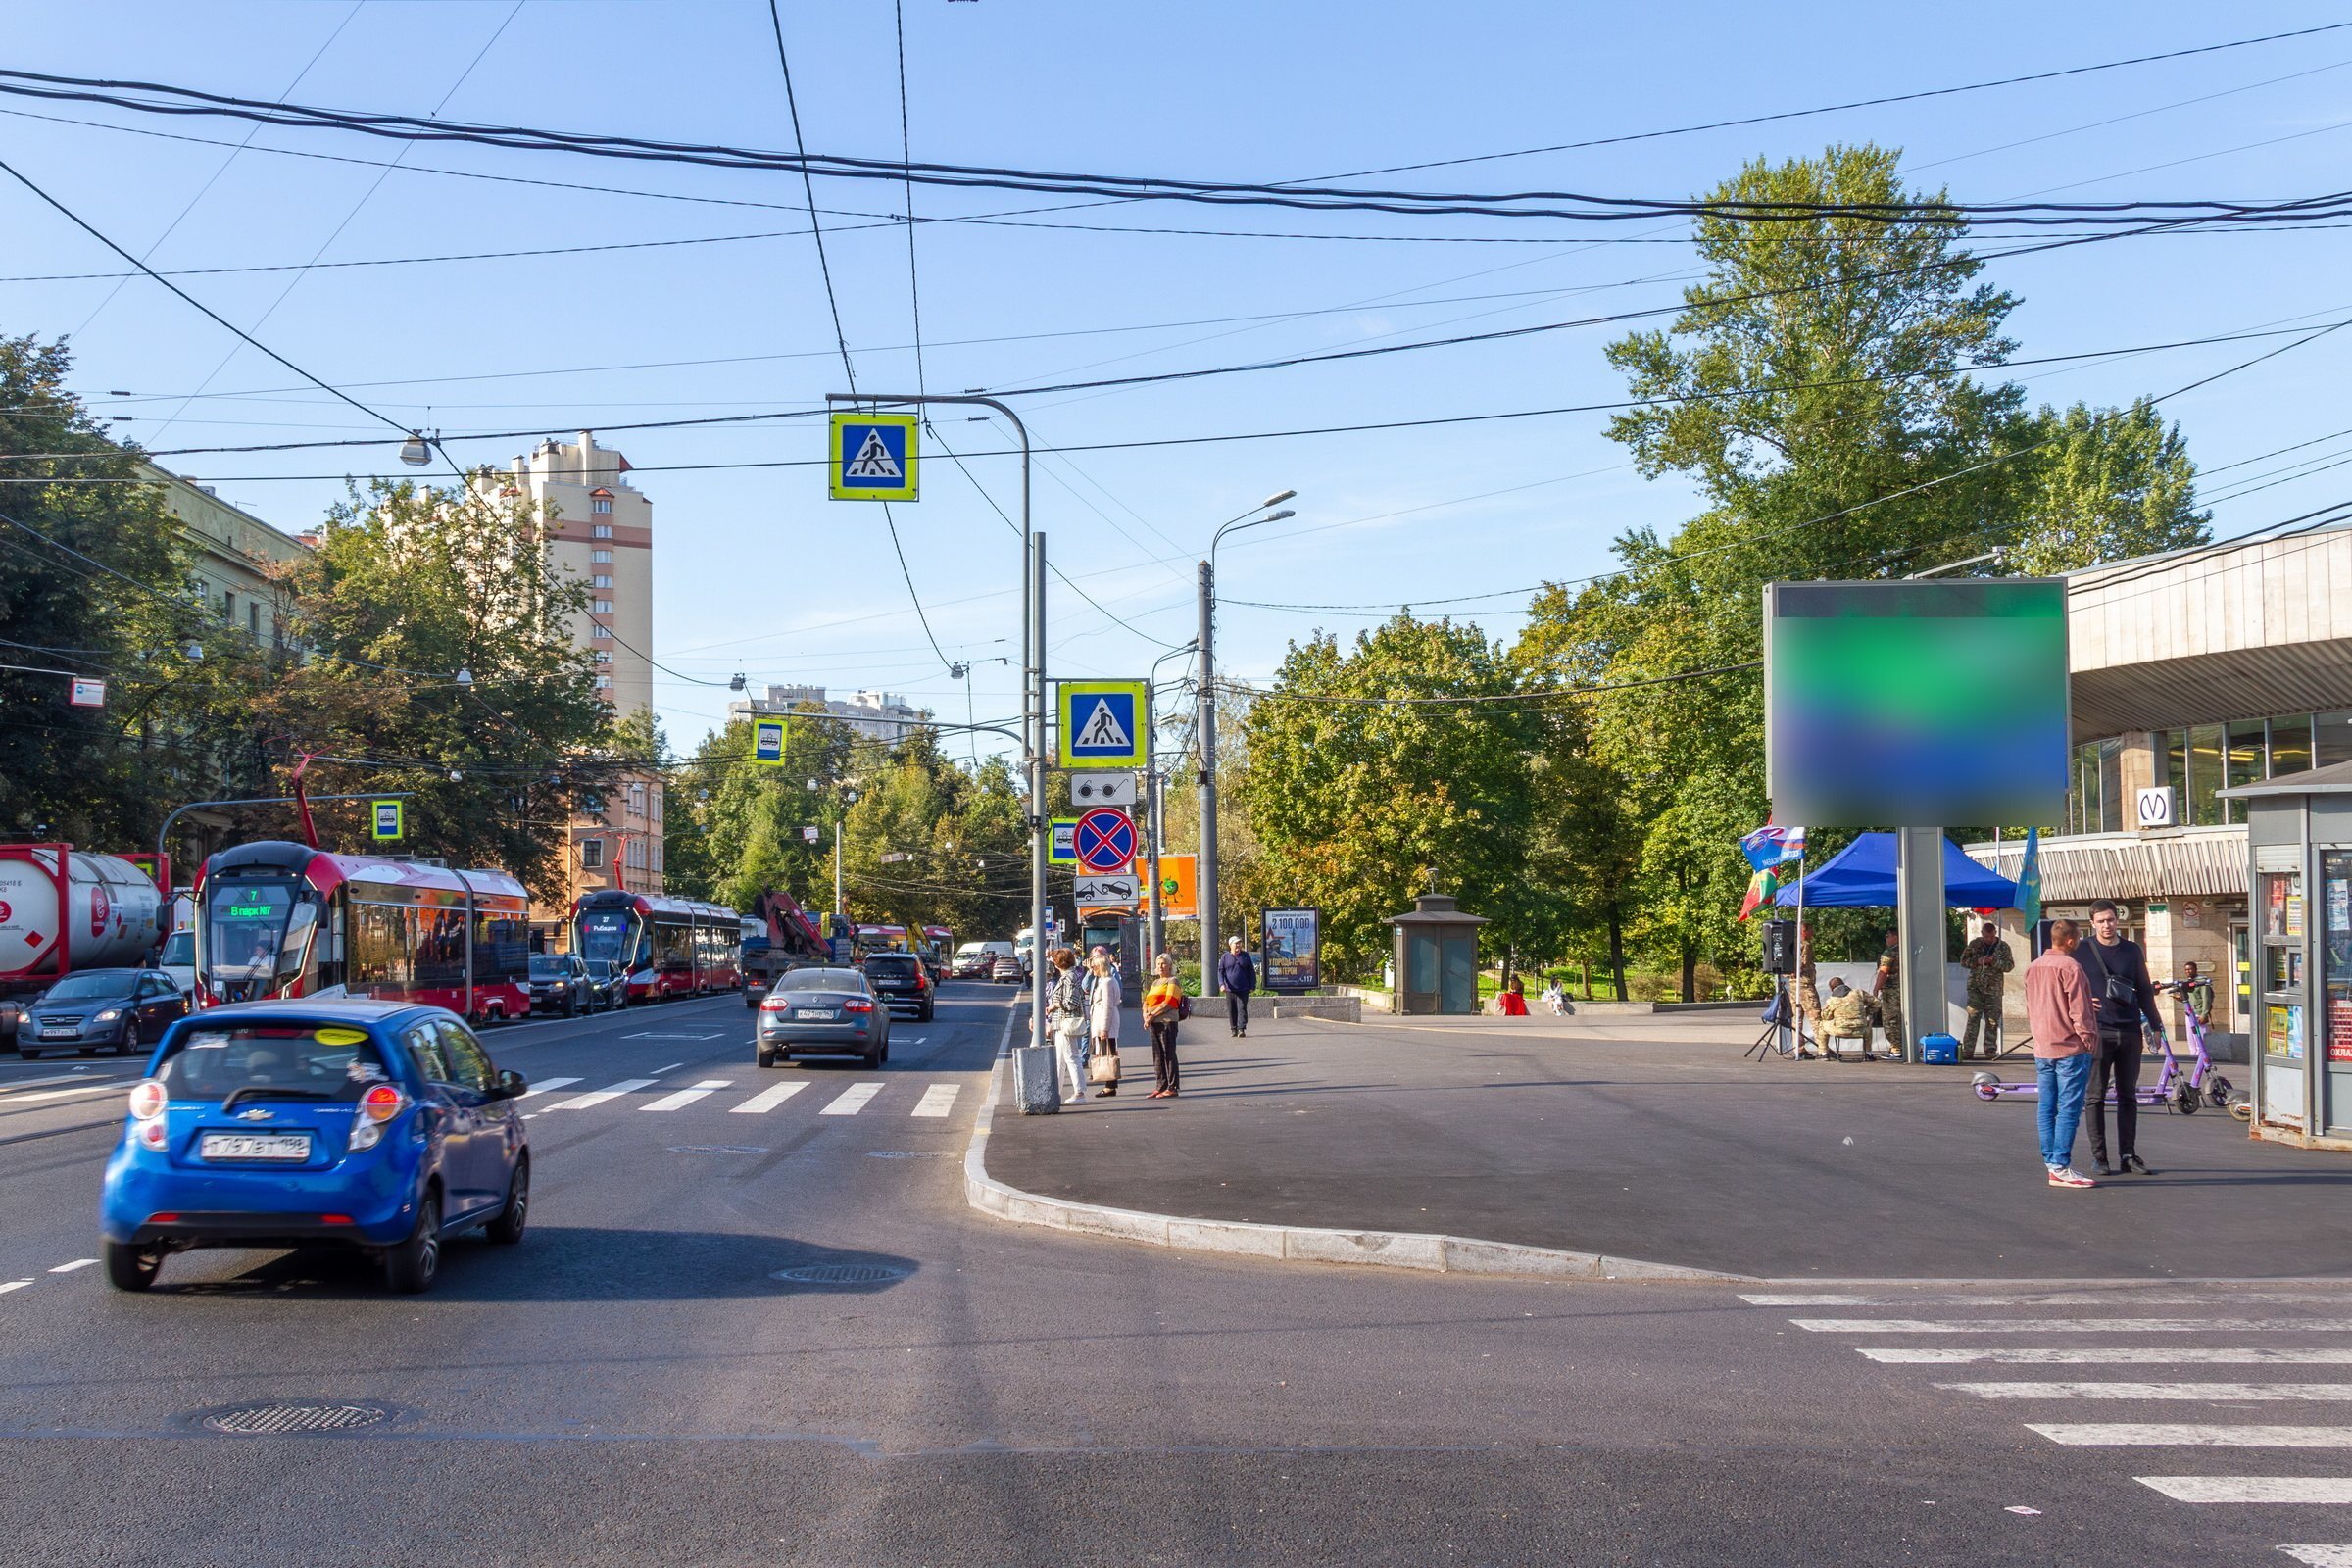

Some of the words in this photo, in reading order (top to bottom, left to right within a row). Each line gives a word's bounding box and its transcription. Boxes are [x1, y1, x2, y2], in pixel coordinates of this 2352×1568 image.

[251, 890, 257, 901] 7
[230, 906, 238, 916] В
[239, 907, 259, 917] парк
[1272, 918, 1277, 929] 2
[1279, 918, 1293, 929] 100
[1295, 918, 1310, 929] 000
